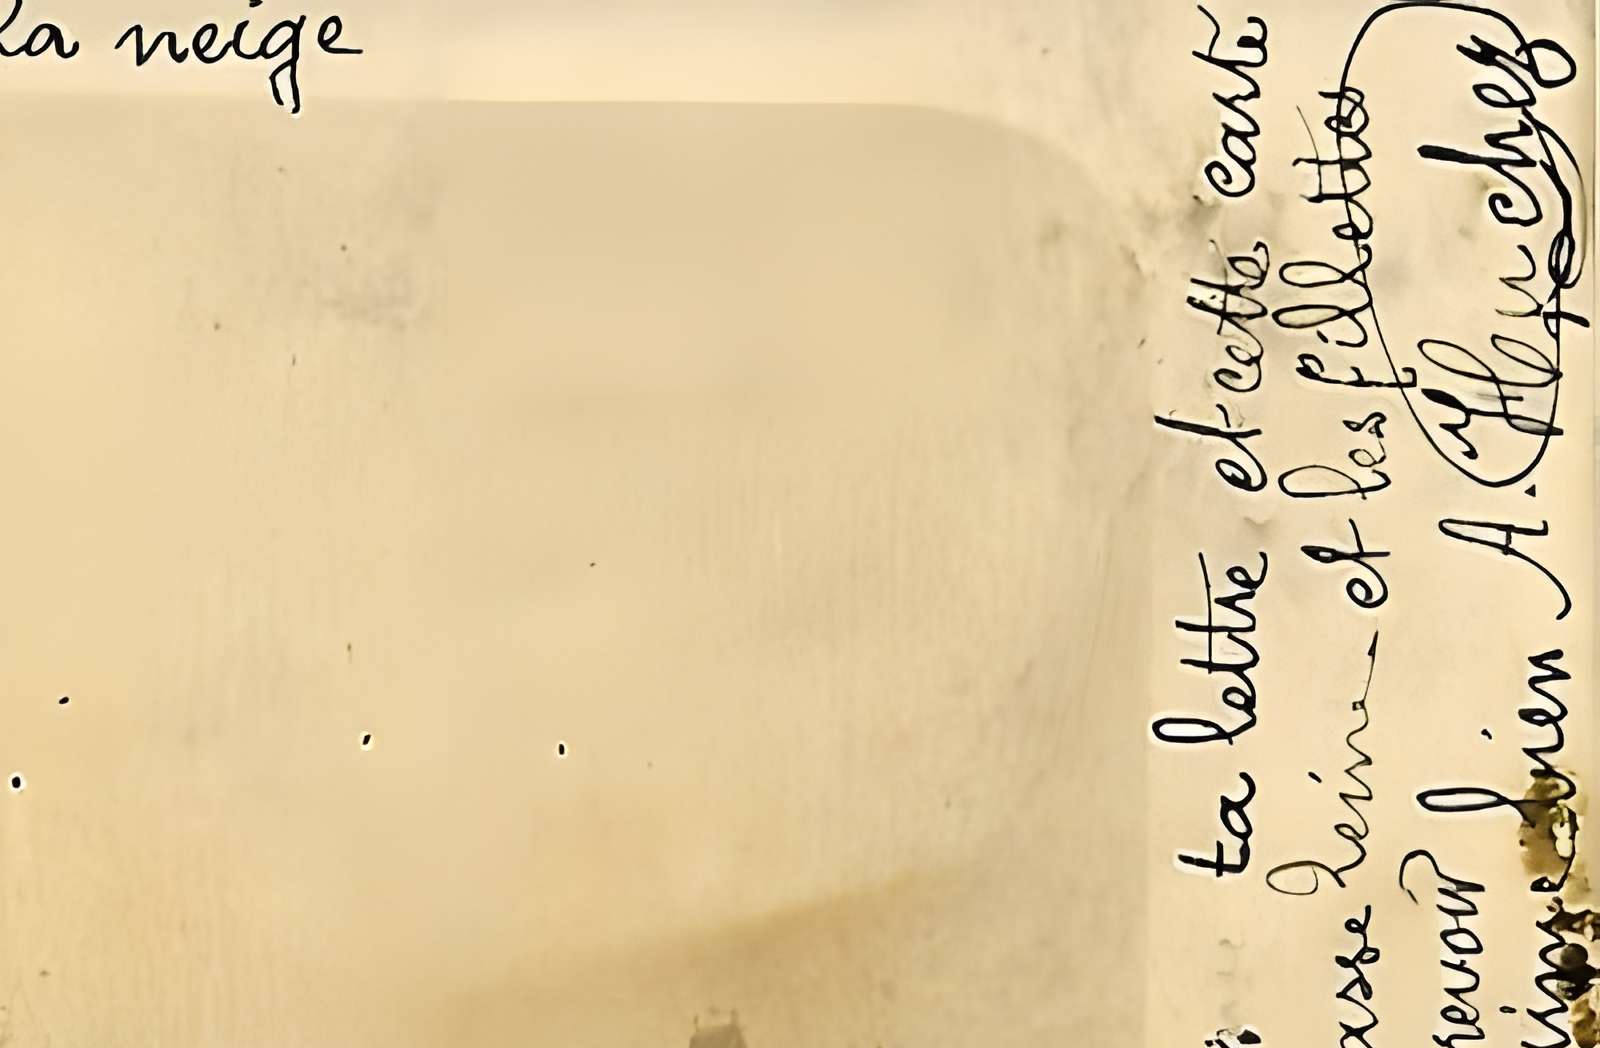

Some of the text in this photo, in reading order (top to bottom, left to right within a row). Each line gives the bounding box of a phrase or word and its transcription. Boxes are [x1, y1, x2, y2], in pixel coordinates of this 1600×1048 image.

[115, 0, 364, 114] neige
[1190, 3, 1268, 197] carte
[1271, 84, 1417, 387] fillettes
[1185, 238, 1270, 392] cette
[1153, 403, 1268, 491] et
[1278, 410, 1393, 495] les
[1300, 517, 1390, 607] et
[1151, 550, 1267, 743] lettre
[1415, 647, 1579, 821] bien
[1177, 770, 1256, 878] ta
